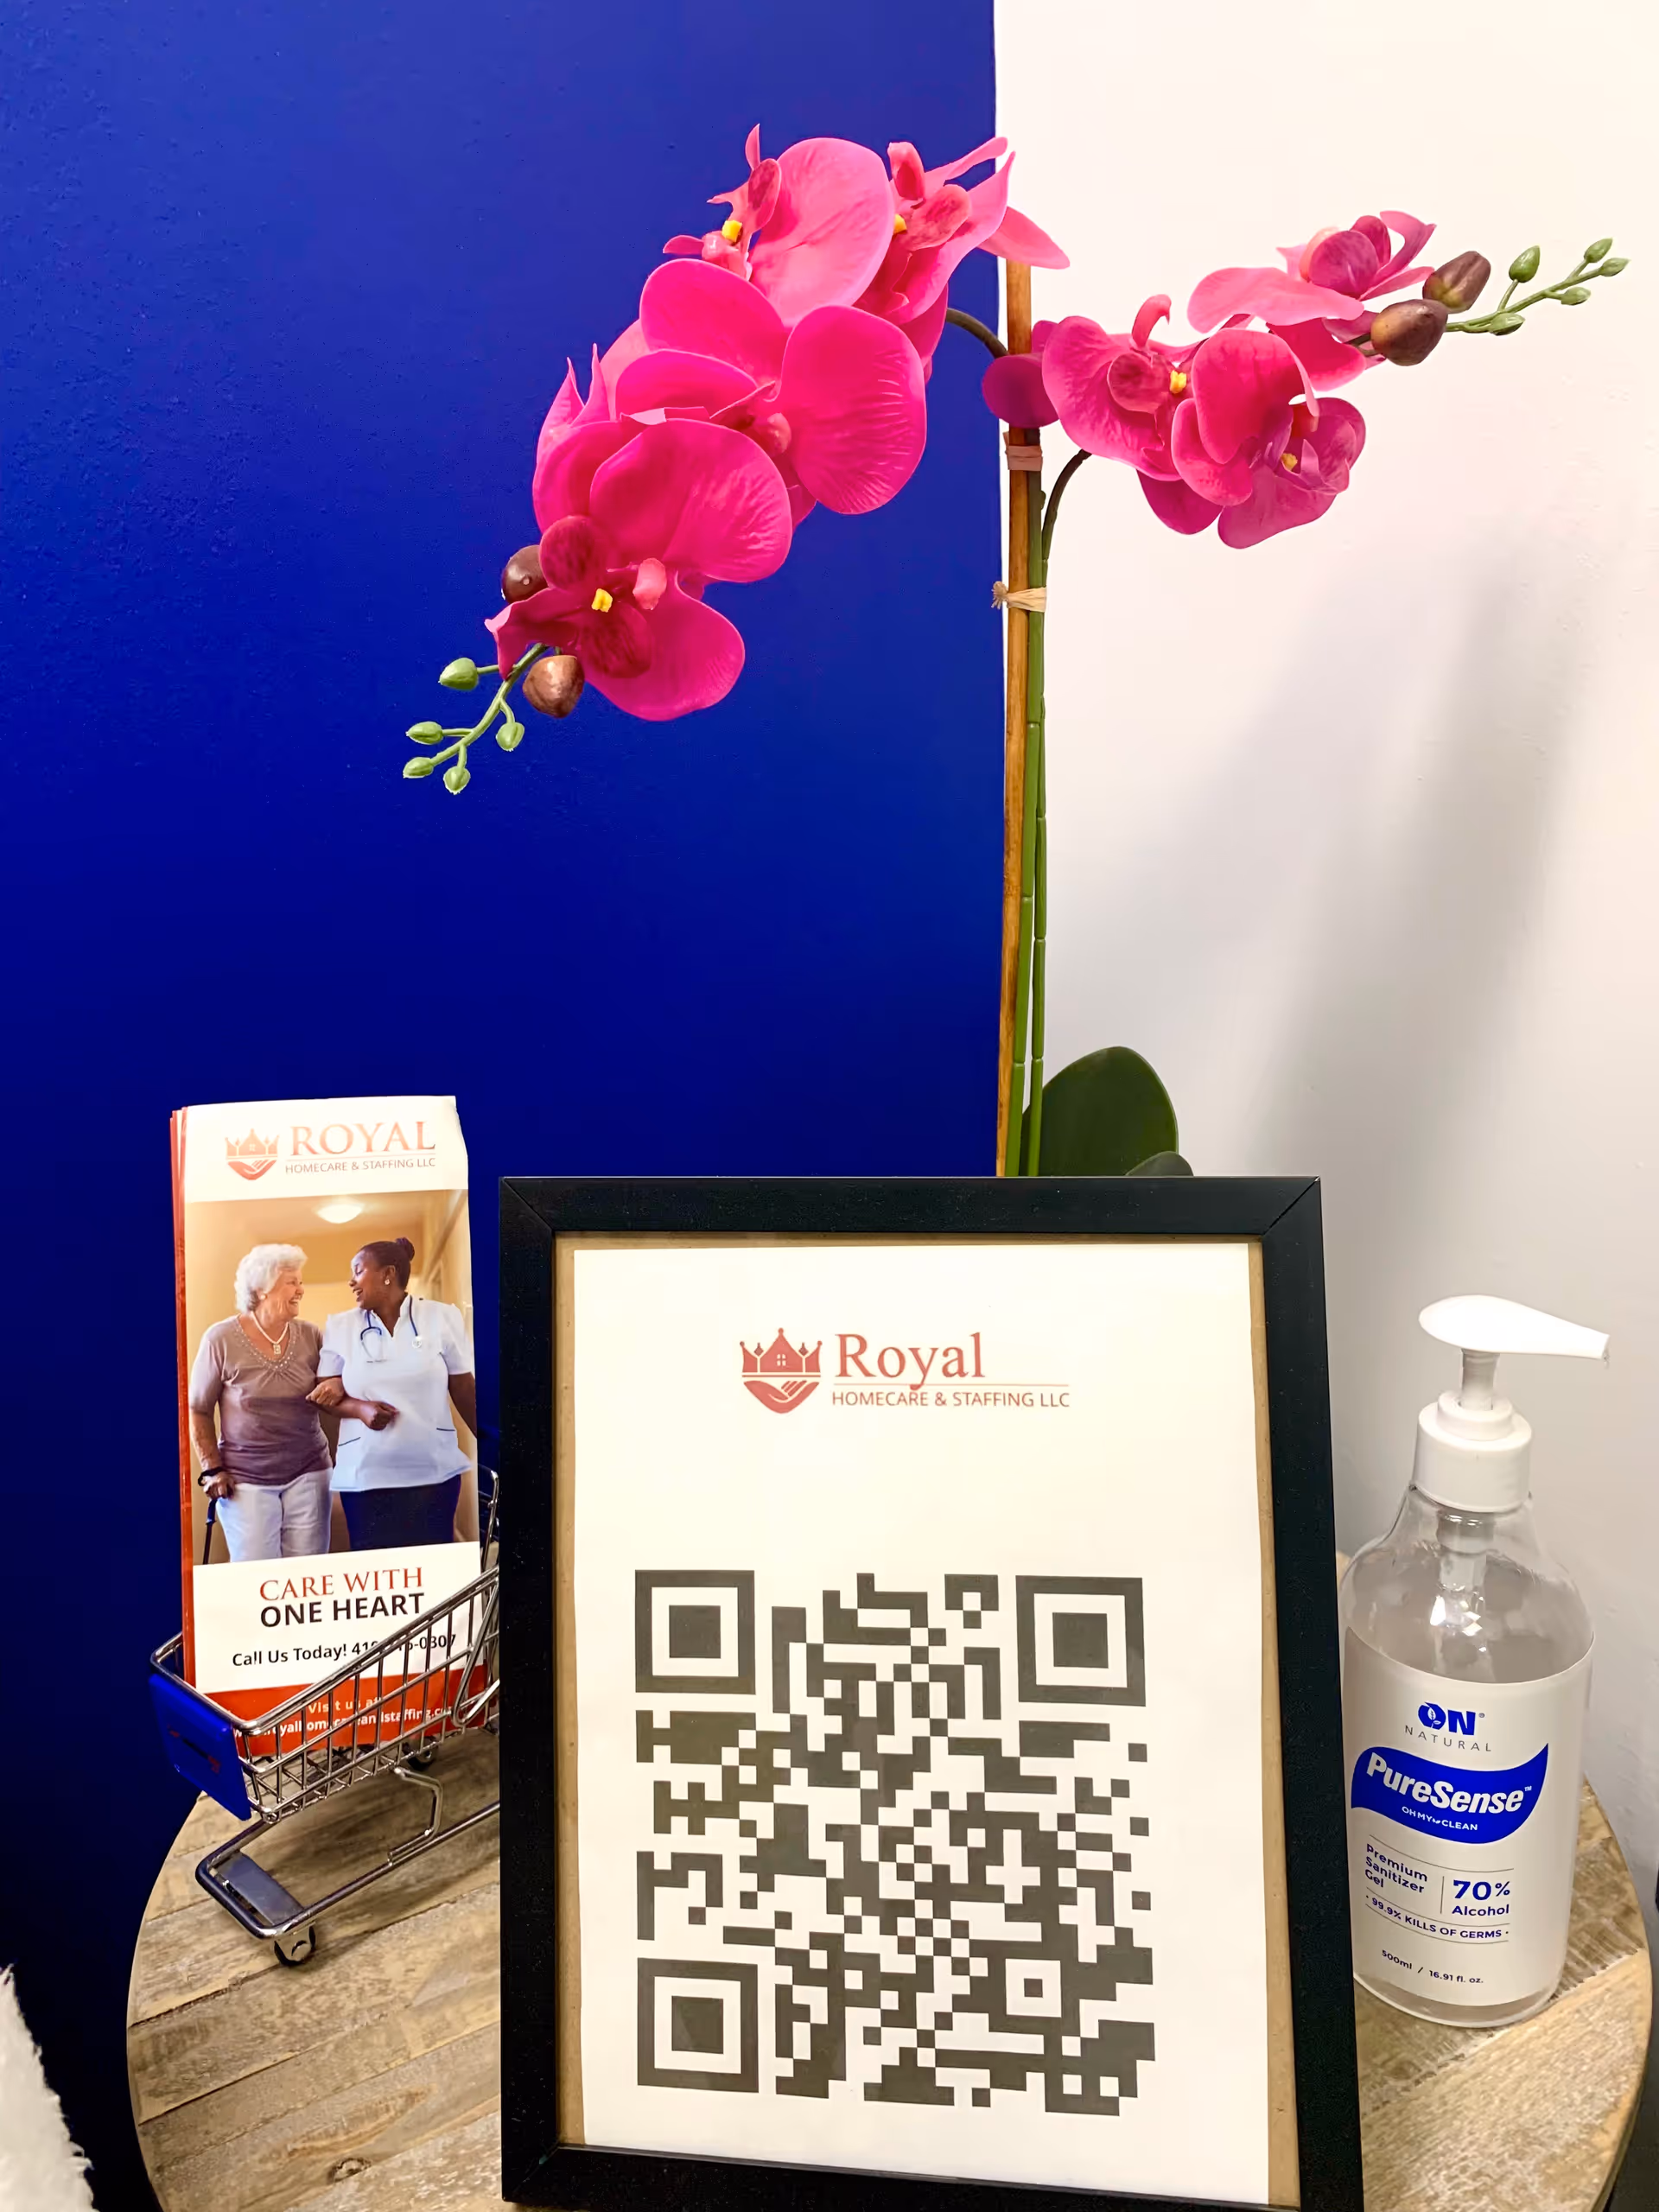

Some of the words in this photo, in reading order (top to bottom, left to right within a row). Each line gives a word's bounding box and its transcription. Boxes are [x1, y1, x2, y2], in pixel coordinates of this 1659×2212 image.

[289, 1121, 436, 1156] ROYAL
[284, 1160, 348, 1174] HOMECARE
[350, 1160, 359, 1171] &
[362, 1158, 415, 1171] STAFFING
[416, 1157, 436, 1168] LLC
[835, 1332, 985, 1391] Royal
[832, 1391, 929, 1407] HOMECARE
[934, 1392, 948, 1407] &
[952, 1392, 1035, 1408] STAFFING
[1040, 1393, 1071, 1408] LLC
[259, 1574, 334, 1602] CARE
[343, 1567, 423, 1592] WITH
[260, 1601, 323, 1628] ONE
[333, 1592, 425, 1621] HEART
[232, 1650, 262, 1667] Call
[267, 1649, 289, 1663] Us
[293, 1643, 347, 1662] Today!
[1404, 1725, 1492, 1752] NATURAL
[1440, 1819, 1478, 1831] CLEAN
[1365, 1856, 1425, 1893] Sanitizer
[1366, 1843, 1427, 1882] Premium
[1364, 1868, 1384, 1888] Gel
[1452, 1879, 1510, 1900] 70%
[1371, 1897, 1402, 1920] 99.9%
[1404, 1914, 1437, 1933] KILLS
[1439, 1927, 1458, 1936] OF
[1459, 1929, 1503, 1939] GERMS
[1452, 1904, 1510, 1916] Alcohol
[1382, 1949, 1413, 1970] 500ml
[1428, 1969, 1453, 1982] 16.91
